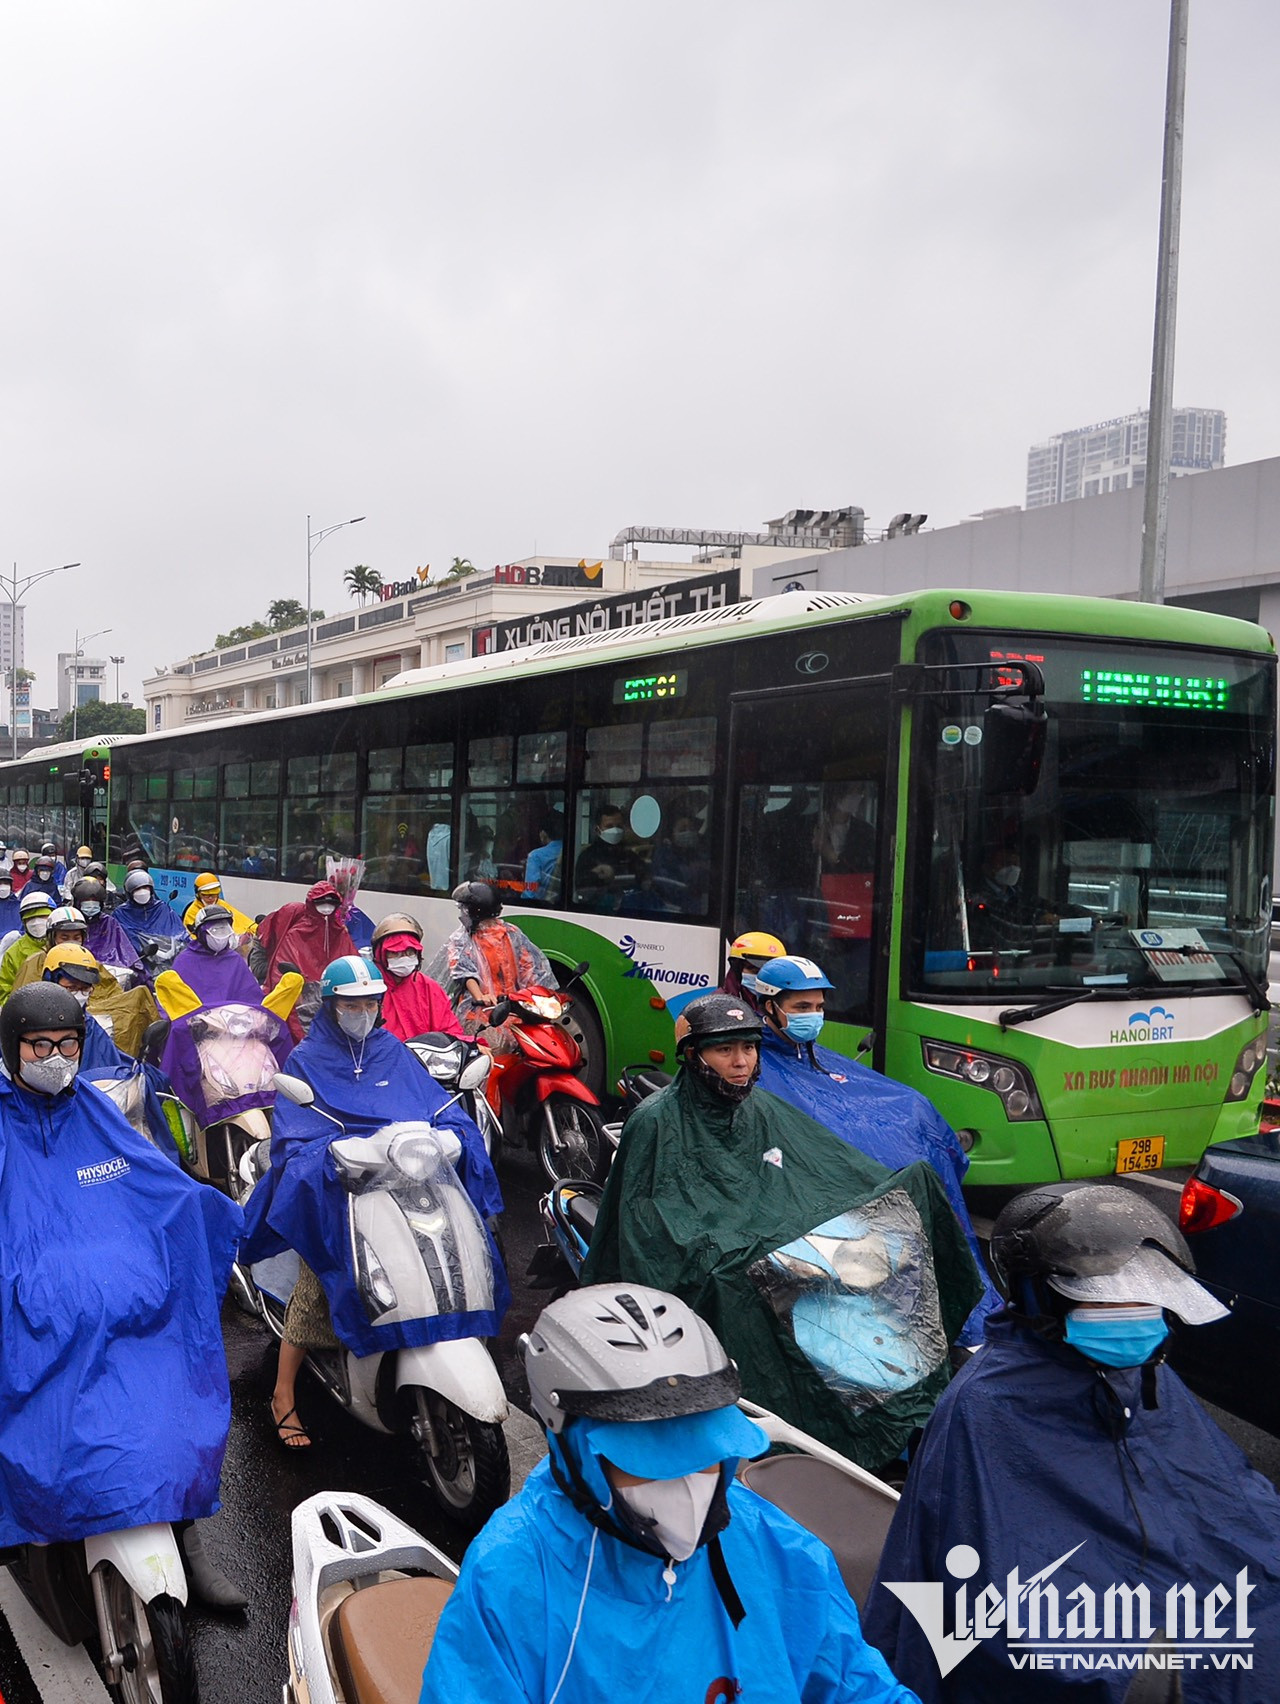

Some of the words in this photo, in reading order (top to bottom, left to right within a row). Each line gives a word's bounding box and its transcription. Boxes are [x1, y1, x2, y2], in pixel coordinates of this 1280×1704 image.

[494, 564, 579, 587] HDBank
[379, 576, 418, 602] HDBank
[504, 615, 571, 651] XƯỞNG
[616, 586, 683, 628] THẤT
[1088, 1068, 1117, 1090] BUS
[1119, 1065, 1169, 1089] NHANH
[1173, 1060, 1191, 1084] HÀ
[1194, 1058, 1219, 1087] NỘI
[1131, 1138, 1152, 1155] 29B
[76, 1156, 130, 1181] PHYSIOGEL
[1122, 1153, 1158, 1172] 154.59
